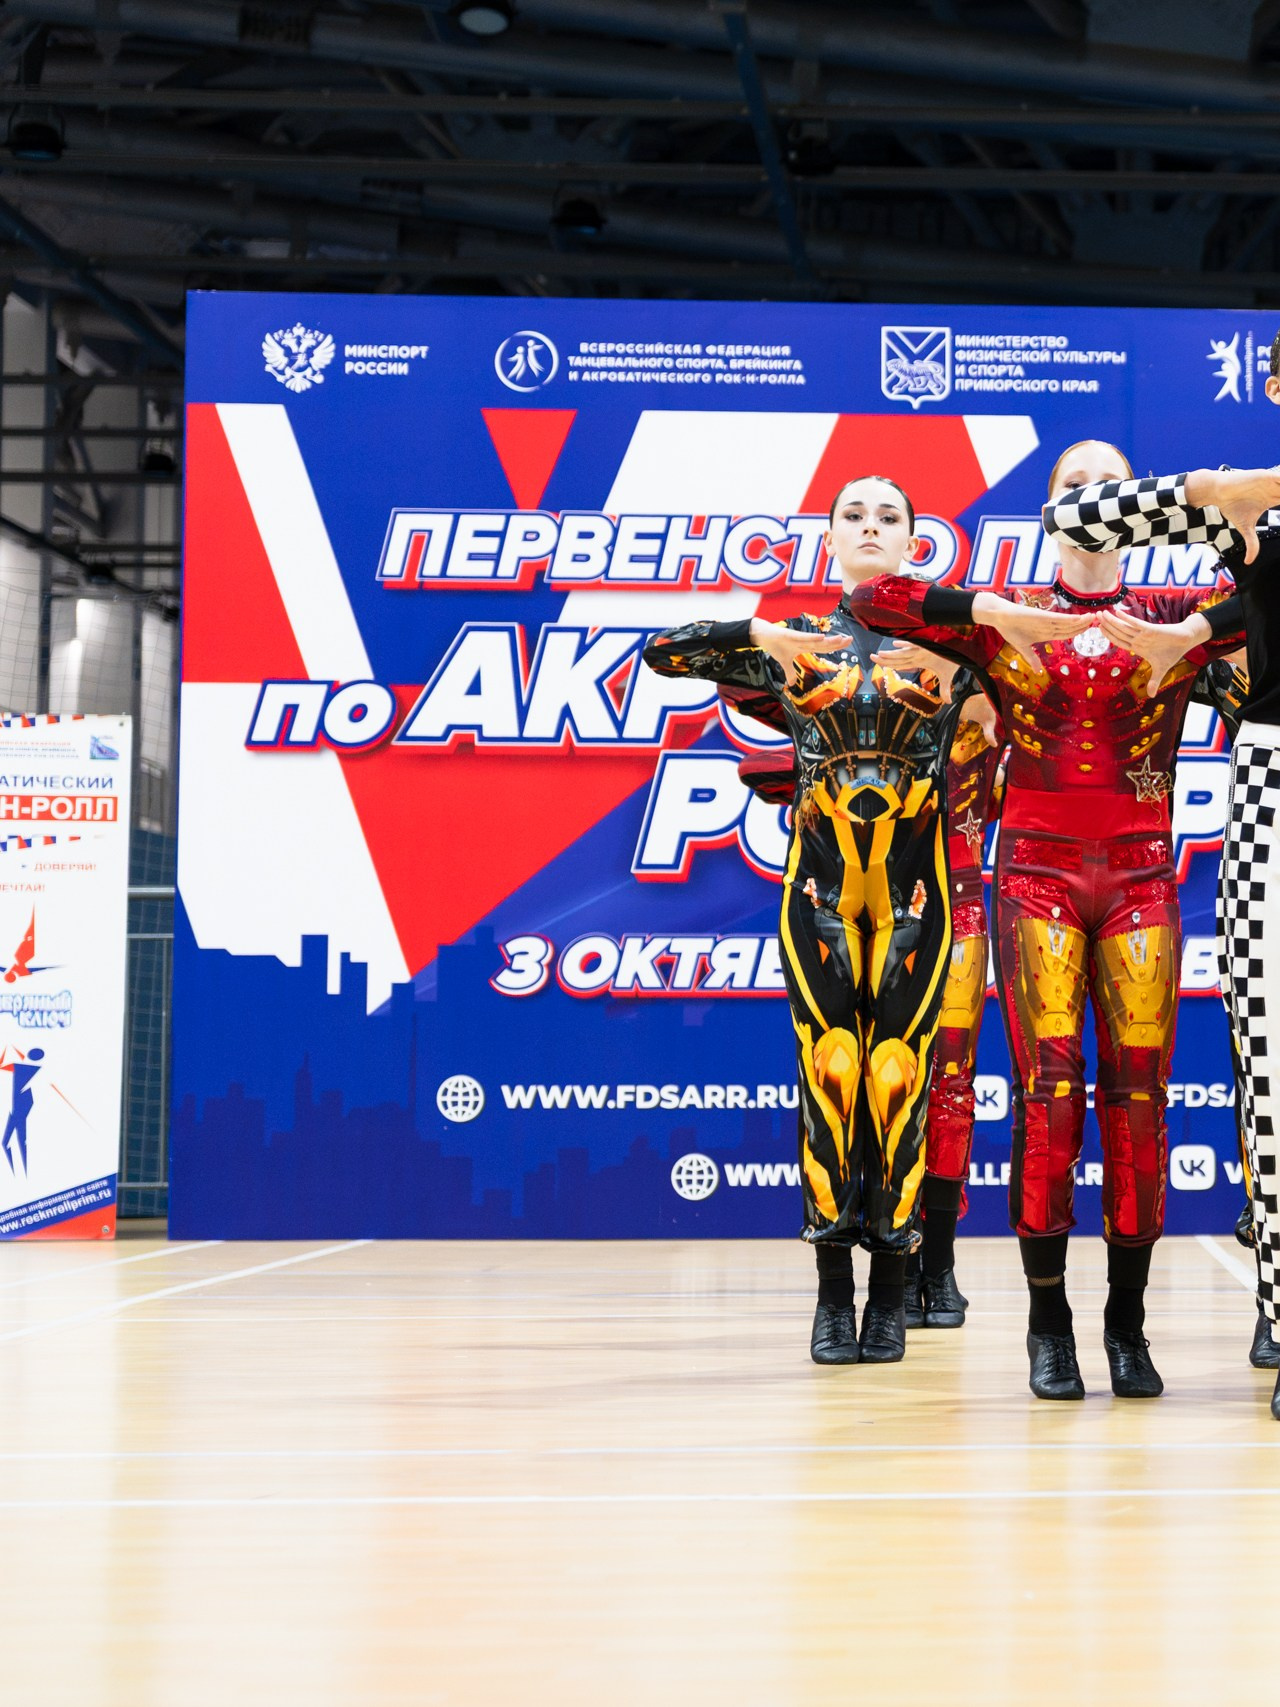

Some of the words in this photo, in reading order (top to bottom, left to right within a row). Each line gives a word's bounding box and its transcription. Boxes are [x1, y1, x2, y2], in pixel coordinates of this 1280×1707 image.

[579, 342, 702, 356] ВСЕРОССИЙСКАЯ
[705, 345, 791, 357] ФЕДЕРАЦИЯ
[955, 335, 1069, 349] МИНИСТЕРСТВО
[344, 344, 430, 359] МИНСПОРТ
[955, 349, 1051, 363] ФИЗИЧЕСКОЙ
[1053, 350, 1127, 365] КУЛЬТУРЫ
[344, 361, 409, 376] РОССИИ
[567, 356, 674, 369] ТАНЦЕВАЛЬНОГО
[729, 357, 803, 371] БРЕЙКИНГА
[955, 364, 966, 376] И
[968, 364, 1025, 377] СПОРТА
[568, 371, 579, 382] И
[581, 371, 713, 384] АКРОБАТИЧЕСКОГО
[955, 378, 1061, 392] ПРИМОРСКОГО
[1062, 379, 1100, 393] КРАЯ
[376, 508, 958, 588] ПЕРВЕНСТО
[0, 796, 115, 820] Н-РОЛЛ
[490, 935, 553, 996] 3
[501, 1084, 800, 1110] WWW.FDSARR.RU
